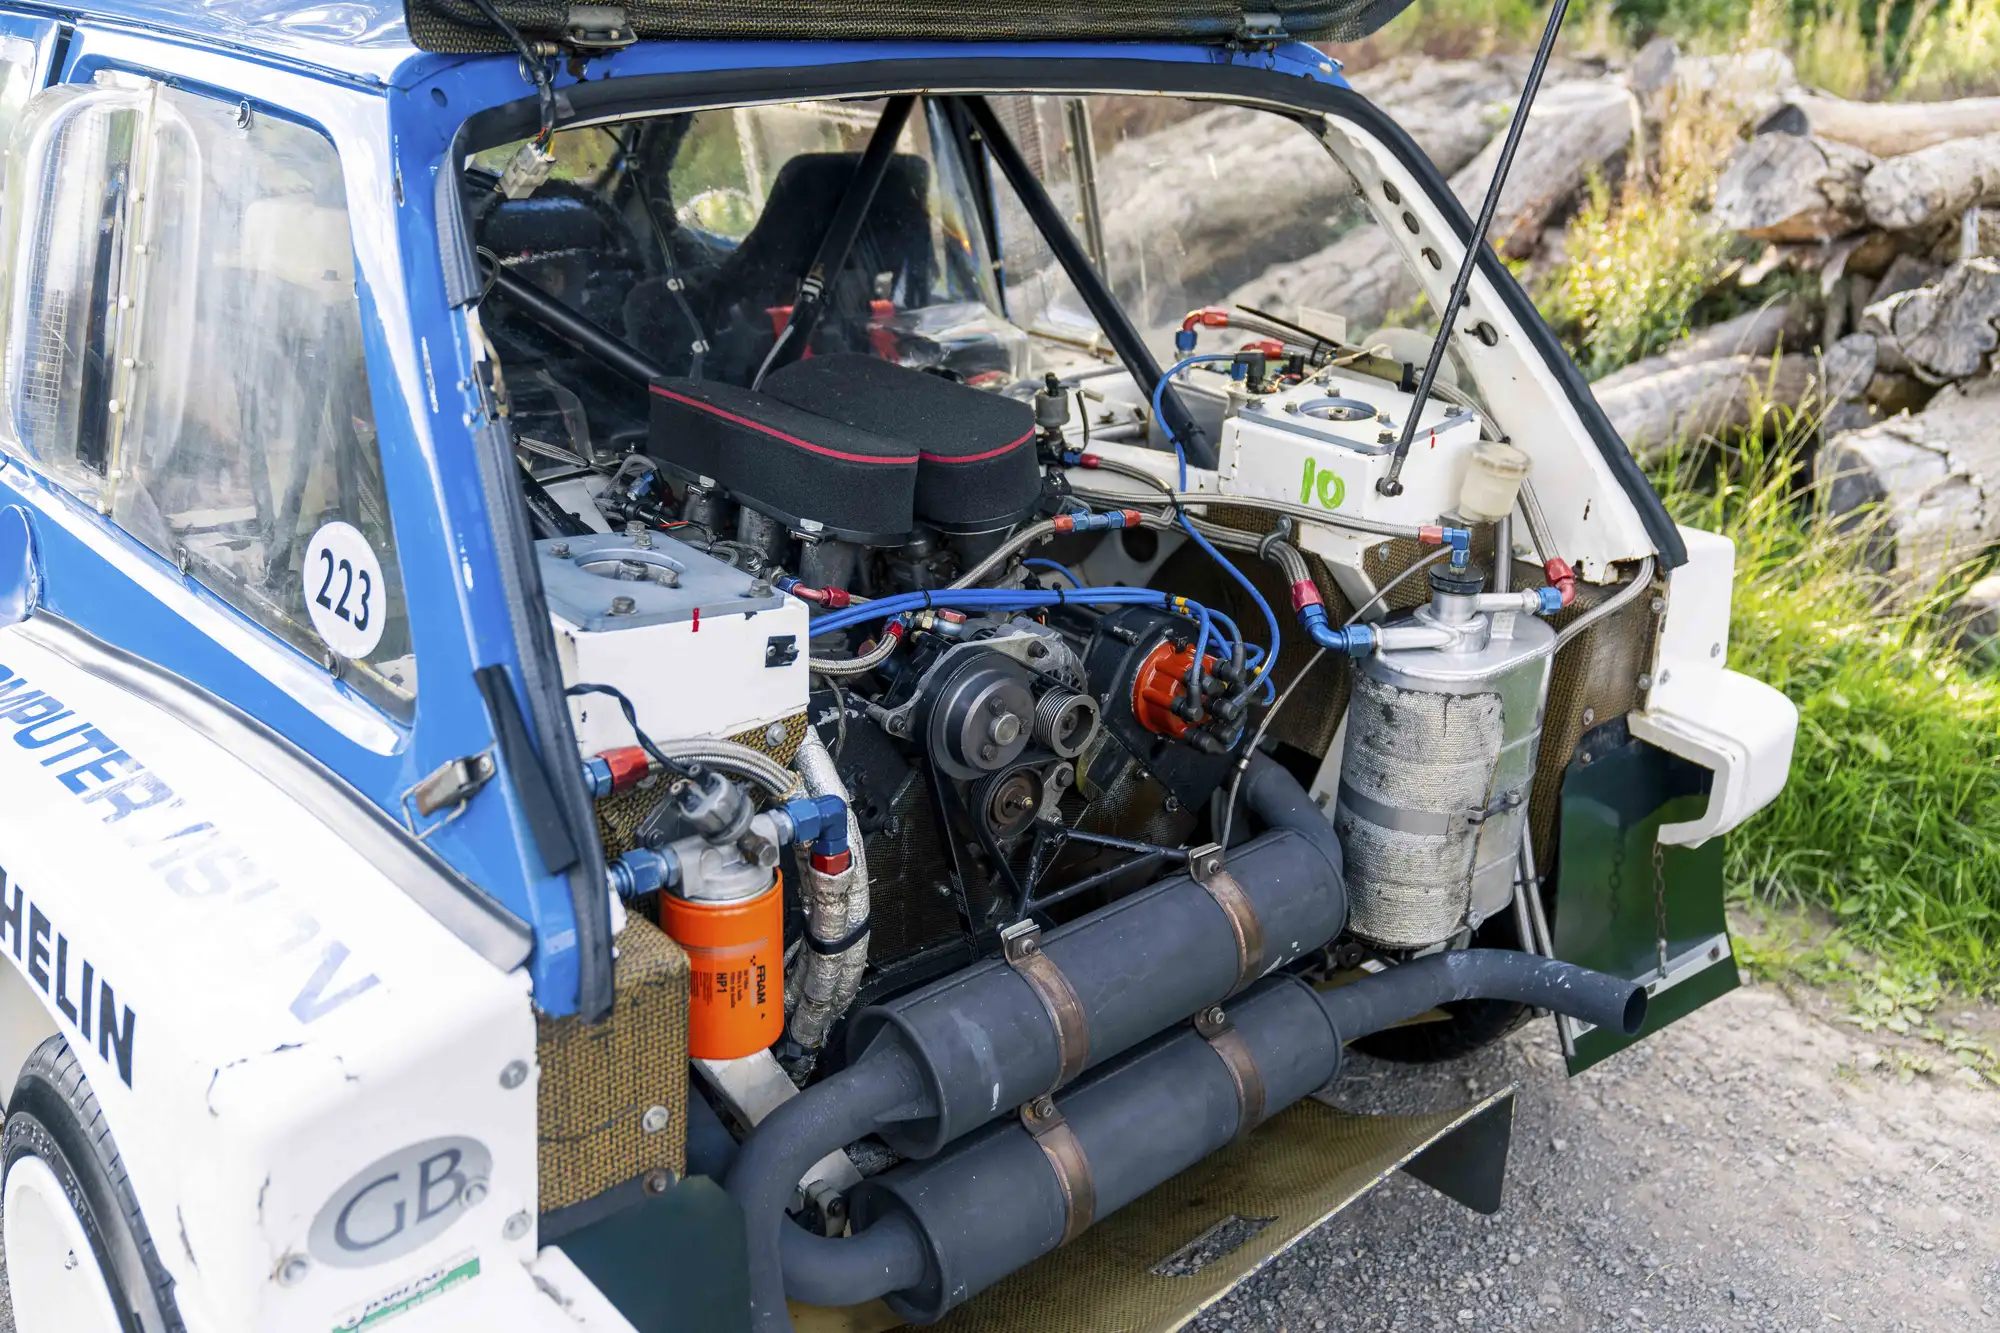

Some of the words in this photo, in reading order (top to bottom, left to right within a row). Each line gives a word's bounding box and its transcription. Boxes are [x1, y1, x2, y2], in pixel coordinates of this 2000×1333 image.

[1300, 457, 1345, 510] 10
[316, 548, 371, 631] 223
[0, 663, 173, 824] MPUTER
[0, 865, 136, 1091] HELIN
[716, 972, 728, 993] HP1
[757, 965, 766, 1005] FRAM
[334, 1148, 467, 1251] GB
